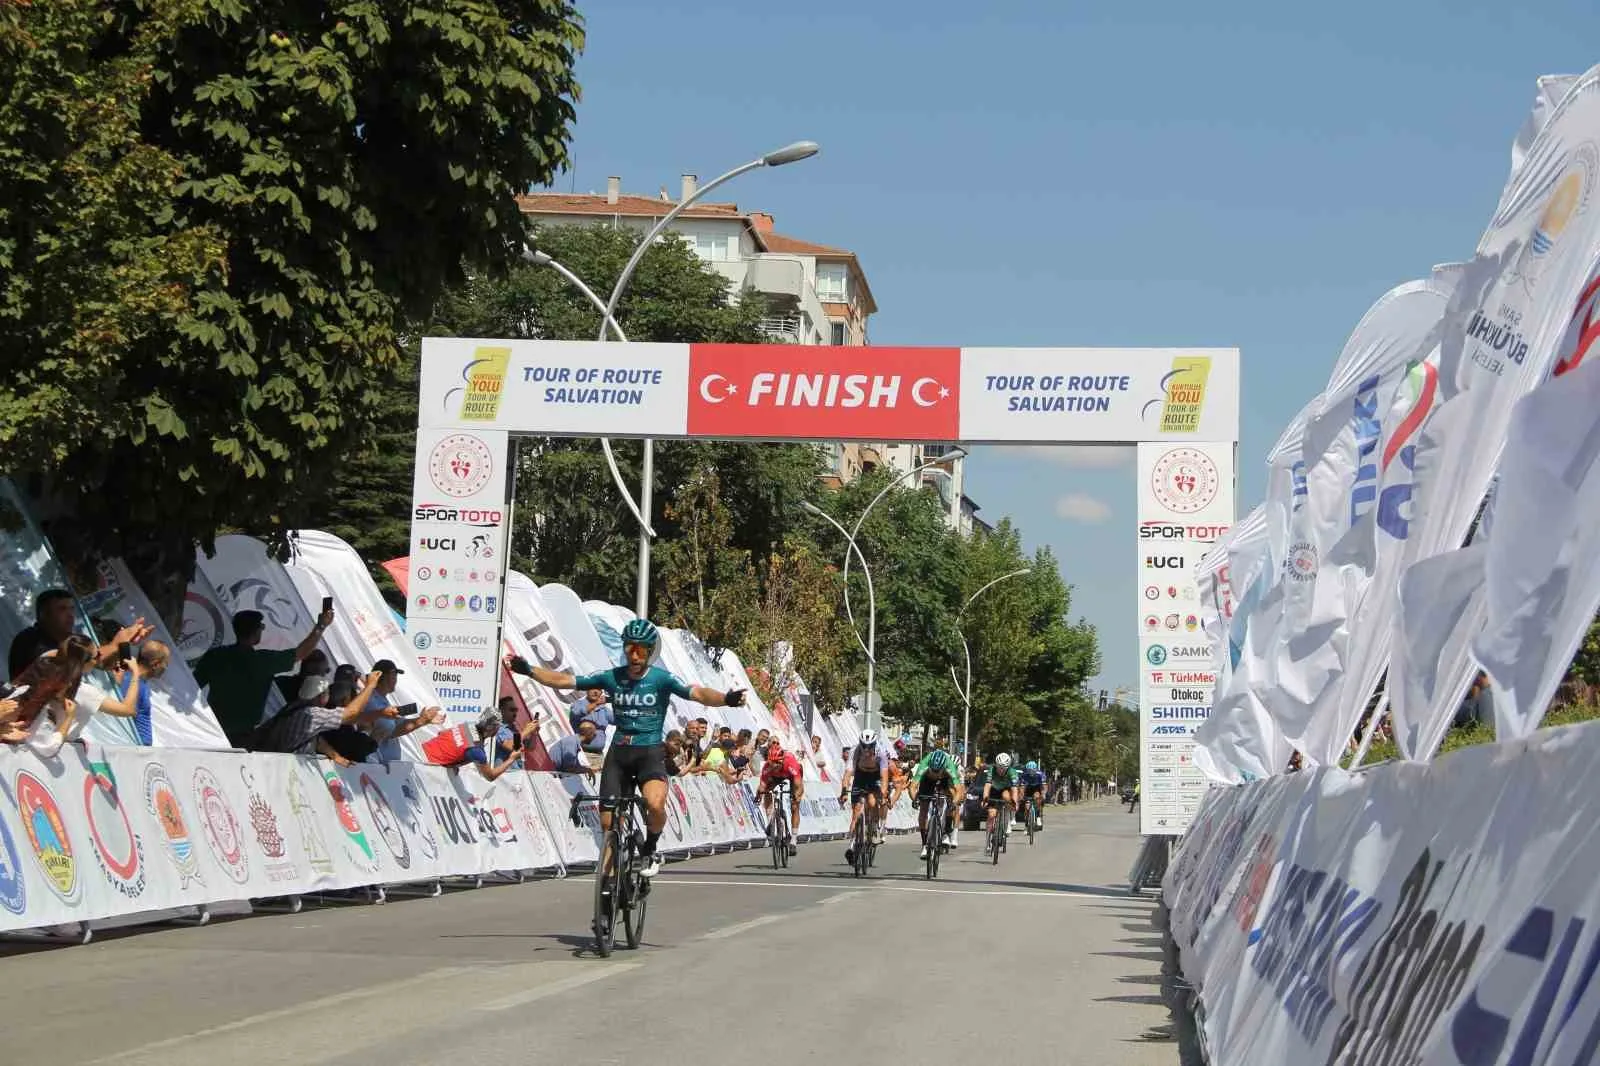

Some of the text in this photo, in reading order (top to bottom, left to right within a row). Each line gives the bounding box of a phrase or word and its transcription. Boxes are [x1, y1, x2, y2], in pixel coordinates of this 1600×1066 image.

[523, 367, 663, 386] TOUR OF ROUTE
[986, 376, 1130, 392] TOUR OF ROUTE
[544, 388, 643, 405] SALVATION
[748, 373, 902, 409] FINISH
[465, 402, 497, 412] ROUTE
[1007, 396, 1110, 412] SALVATION
[1167, 405, 1187, 413] TOUR
[1164, 414, 1197, 424] ROUTE
[427, 538, 456, 551] UCI
[1153, 556, 1184, 569] UCI
[436, 634, 488, 645] SAMKON
[1171, 646, 1210, 657] SAMK
[432, 657, 484, 670] TürkMedya
[432, 671, 462, 684] Otokoç
[1169, 672, 1215, 683] TürkMe
[435, 687, 481, 699] MANO
[614, 692, 657, 707] HYLO
[1171, 688, 1204, 702] Otokoç
[1152, 706, 1212, 719] SHIMA
